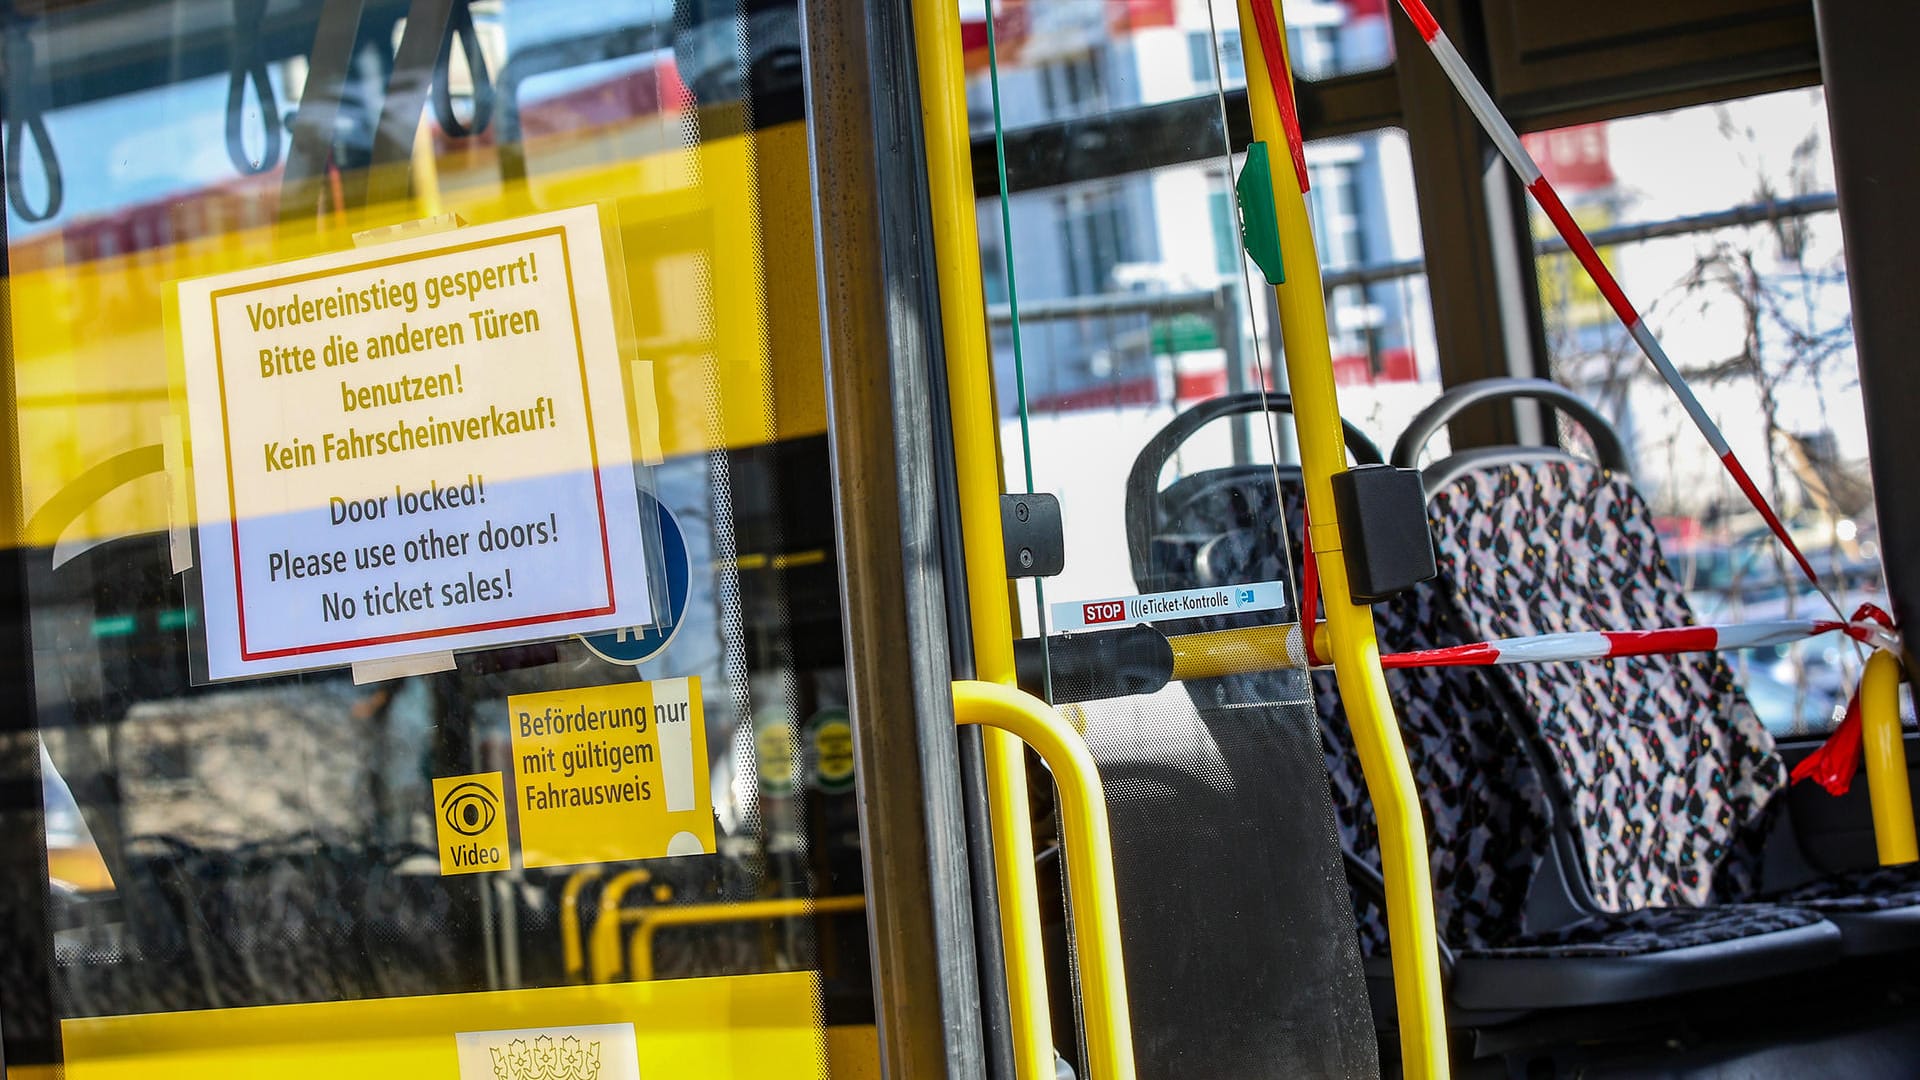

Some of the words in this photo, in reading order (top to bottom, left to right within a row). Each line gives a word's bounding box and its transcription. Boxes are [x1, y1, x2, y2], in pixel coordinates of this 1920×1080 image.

[246, 277, 417, 332] Vordereinstieg
[424, 252, 539, 308] gesperrt!
[259, 345, 316, 378] Bitte
[322, 334, 359, 368] die
[366, 322, 464, 361] anderen
[469, 307, 541, 343] Türen
[340, 364, 465, 412] benutzen!
[264, 437, 316, 472] Kein
[322, 396, 556, 463] Fahrscheinverkauf!
[329, 495, 387, 526] Door
[396, 475, 486, 516] locked!
[269, 549, 347, 582] Please
[355, 540, 396, 570] use
[404, 528, 470, 564] other
[478, 513, 559, 553] doors!
[322, 591, 356, 622] No
[363, 579, 433, 615] ticket
[441, 569, 514, 605] sales!
[1087, 604, 1121, 621] STOP
[519, 703, 648, 738] Beförderung
[653, 700, 689, 725] nur
[522, 747, 556, 775] mit
[562, 740, 655, 777] gültigem
[525, 775, 651, 811] Fahrausweis
[449, 842, 501, 868] Video
